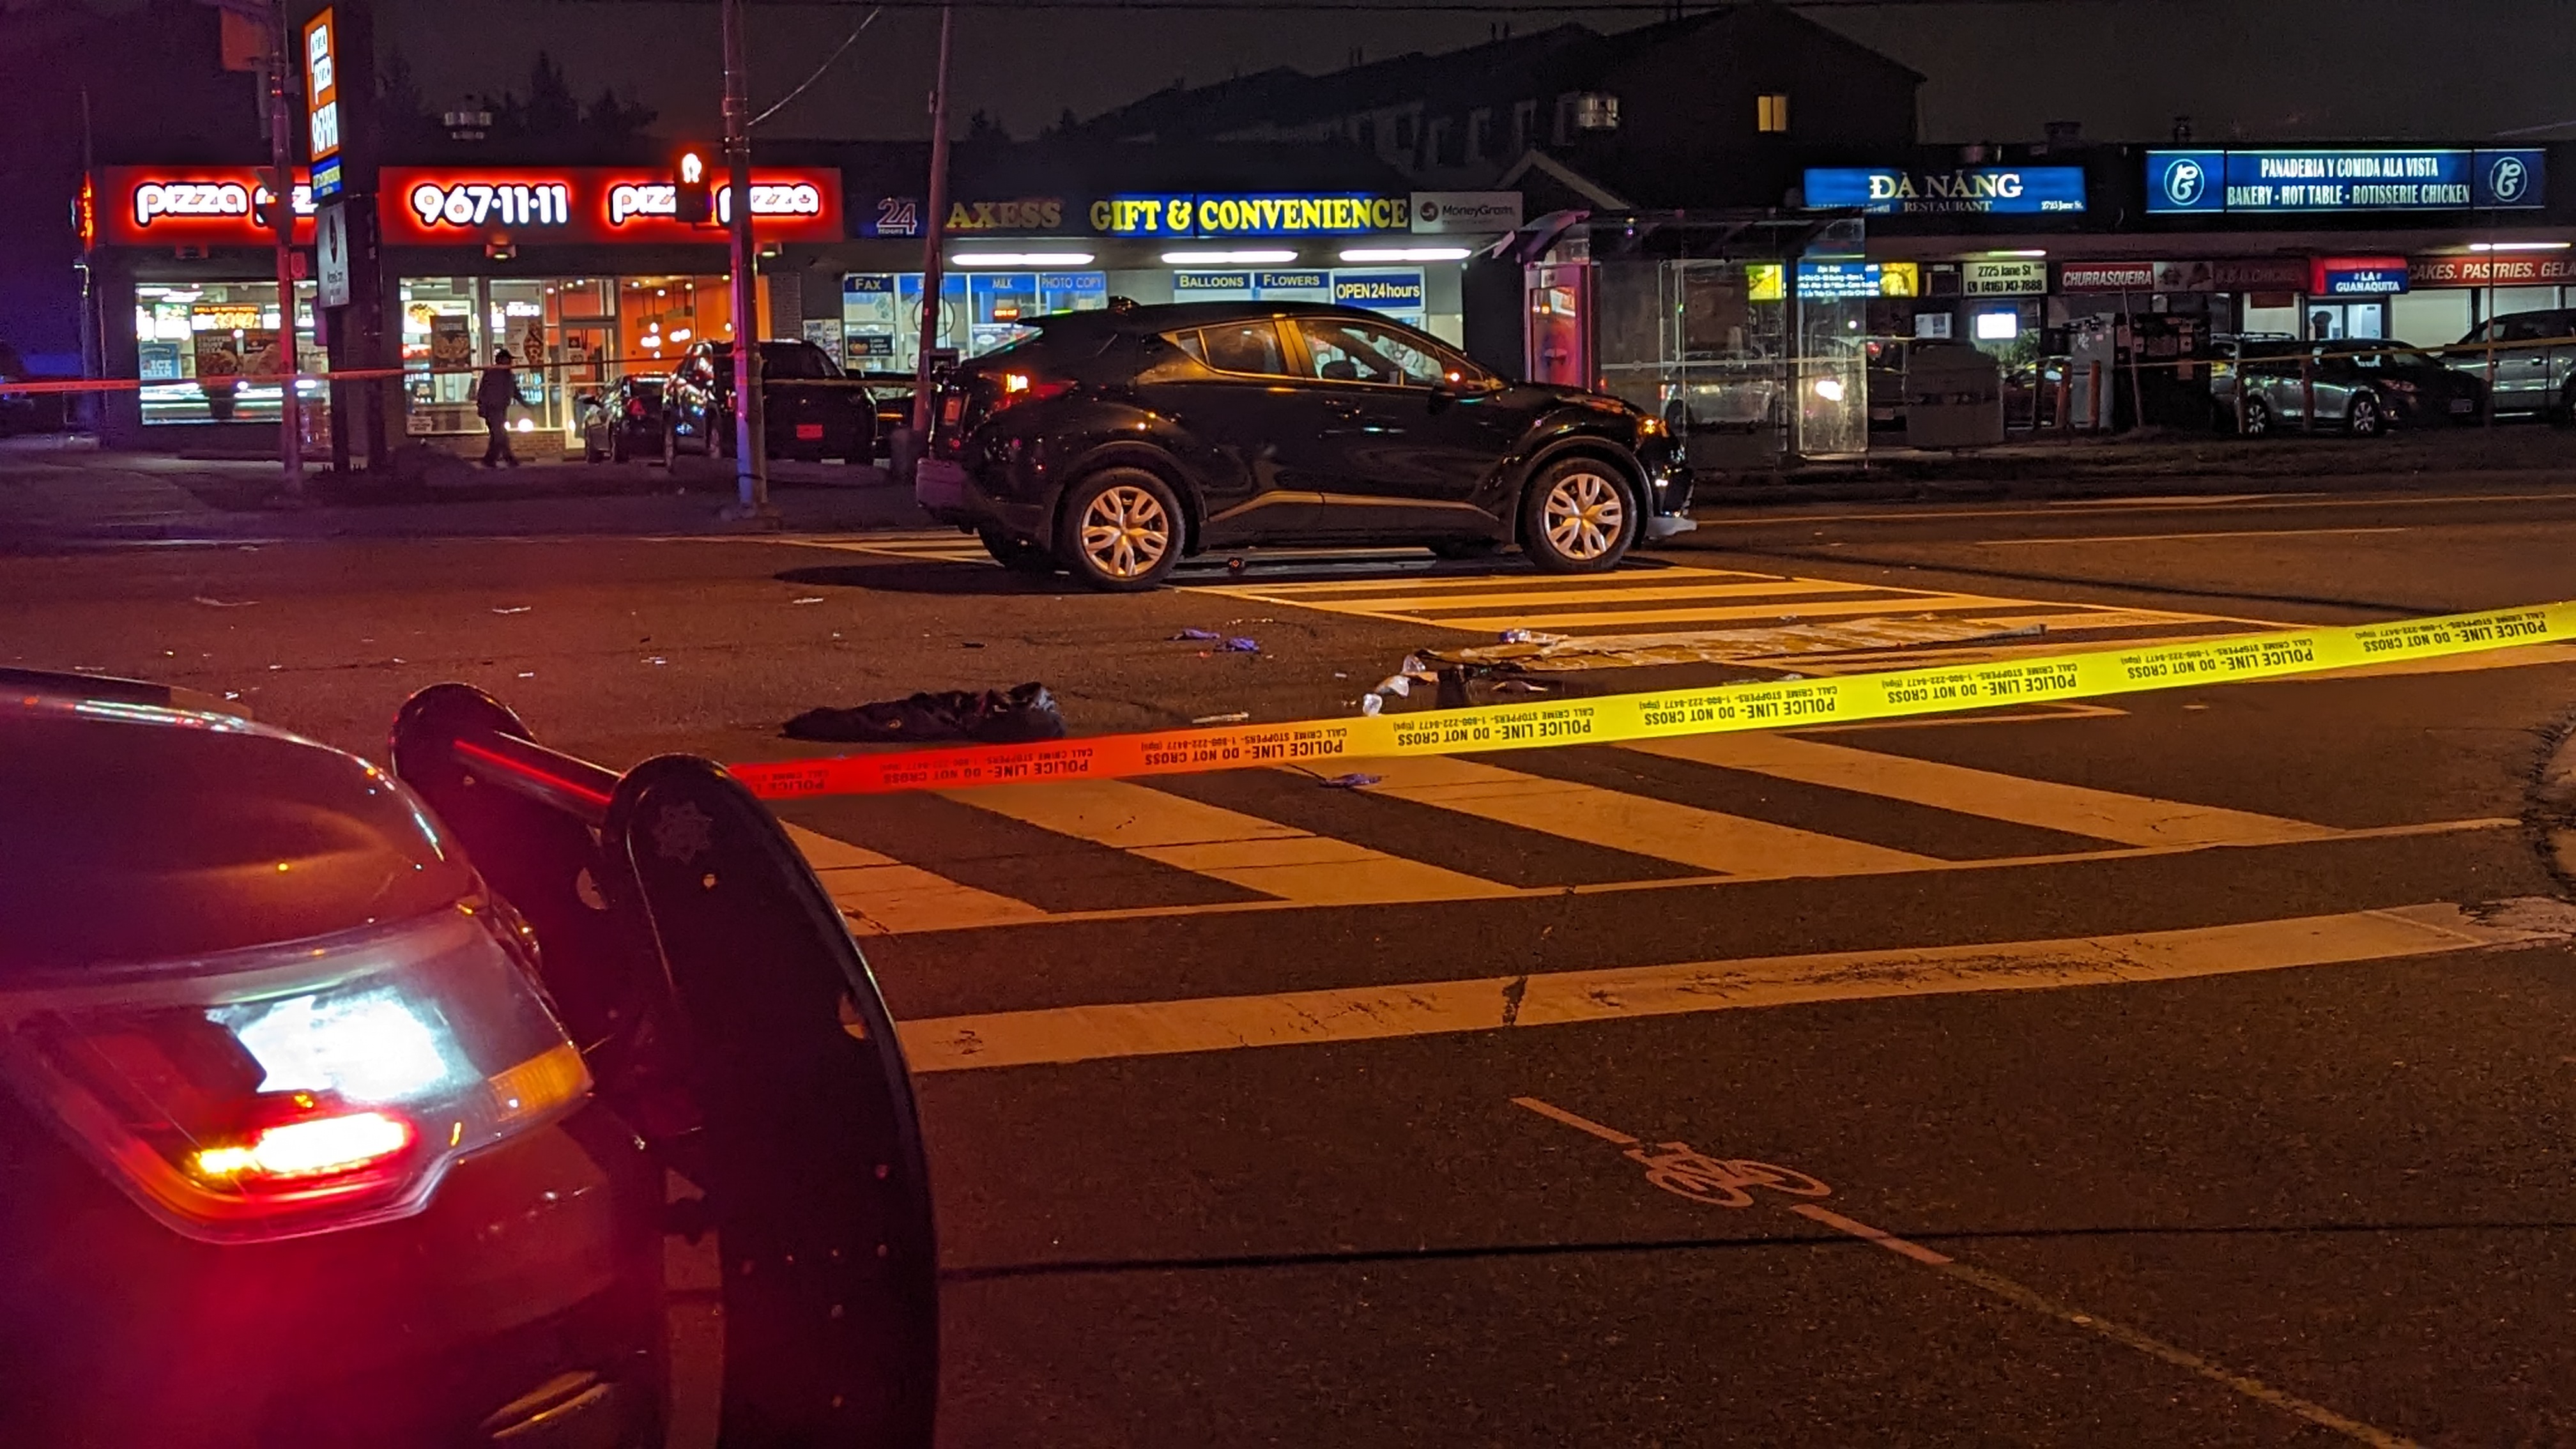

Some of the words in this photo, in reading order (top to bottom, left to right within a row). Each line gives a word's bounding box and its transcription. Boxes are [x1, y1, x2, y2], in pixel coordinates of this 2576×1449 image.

[2261, 158, 2324, 178] PANADERIA
[2327, 158, 2336, 178] Y
[2338, 158, 2381, 178] COMIDA
[2383, 158, 2404, 177] ALA
[2406, 157, 2439, 177] VISTA
[2227, 186, 2273, 205] BAKERY
[2281, 185, 2306, 204] HOT
[2308, 185, 2343, 204] TABLE
[2352, 185, 2419, 204] ROTISSERIE
[2421, 184, 2470, 203] CHICKEN
[137, 185, 247, 224] pizza
[1442, 204, 1515, 218] MoneyGram
[1904, 200, 1993, 212] RESTAURANT
[877, 198, 917, 234] 24
[946, 201, 1061, 229] AXESS
[1089, 200, 1161, 231] GIFT
[1167, 200, 1192, 231] &
[1199, 199, 1409, 231] CONVENIENCE
[1978, 266, 1999, 277] 2725
[2022, 264, 2032, 276] St
[2361, 271, 2375, 281] LA
[2408, 263, 2458, 280] CAKES.
[2462, 262, 2536, 279] PASTRIES.
[854, 277, 882, 291] FAX
[992, 277, 1013, 289] MILK
[1041, 277, 1073, 289] PHOTO
[1075, 277, 1102, 288] COPY
[1179, 275, 1245, 288] BALLOONS
[1263, 273, 1321, 286] FLOWERS
[2062, 270, 2152, 286] CHURRASQUEIRA
[1337, 284, 1371, 300] OPEN
[2336, 281, 2400, 292] GUANAQUITA
[151, 360, 172, 370] ICE
[2496, 621, 2547, 638] POLICE
[2292, 638, 2313, 647] CALL
[2407, 634, 2430, 647] NOT
[2434, 632, 2451, 644] DO
[2214, 645, 2259, 655] STOPPERS-
[2363, 638, 2403, 652] CROSS
[2262, 649, 2313, 666] POLICE
[2026, 666, 2053, 675] CRIME
[2057, 663, 2078, 672] CALL
[2128, 664, 2167, 679] CROSS
[2173, 661, 2195, 674] NOT
[2199, 659, 2216, 671] DO
[1977, 669, 2023, 680] STOPPERS-
[2025, 674, 2076, 692] POLICE
[1787, 688, 1813, 698] CRIME
[1816, 686, 1837, 696] CALL
[1888, 689, 1928, 703] CROSS
[1933, 686, 1956, 699] NOT
[1961, 684, 1977, 696] DO
[1735, 691, 1782, 703] STOPPERS-
[1574, 707, 1594, 717] CALL
[1719, 707, 1735, 719] DO
[1783, 698, 1835, 715] POLICE
[1491, 712, 1538, 723] STOPPERS-
[1543, 710, 1570, 719] CRIME
[1644, 710, 1685, 725] CROSS
[1690, 709, 1713, 722] NOT
[1325, 728, 1347, 737] CALL
[1473, 727, 1489, 740] DO
[1539, 719, 1591, 737] POLICE
[1241, 733, 1289, 744] STOPPERS-
[1294, 730, 1322, 740] CRIME
[1398, 732, 1439, 746] CROSS
[1444, 730, 1468, 742] NOT
[1222, 747, 1239, 759] DO
[1290, 740, 1343, 756] POLICE
[1146, 752, 1187, 765] CROSS
[1193, 749, 1216, 762] NOT
[1034, 760, 1088, 774] POLICE
